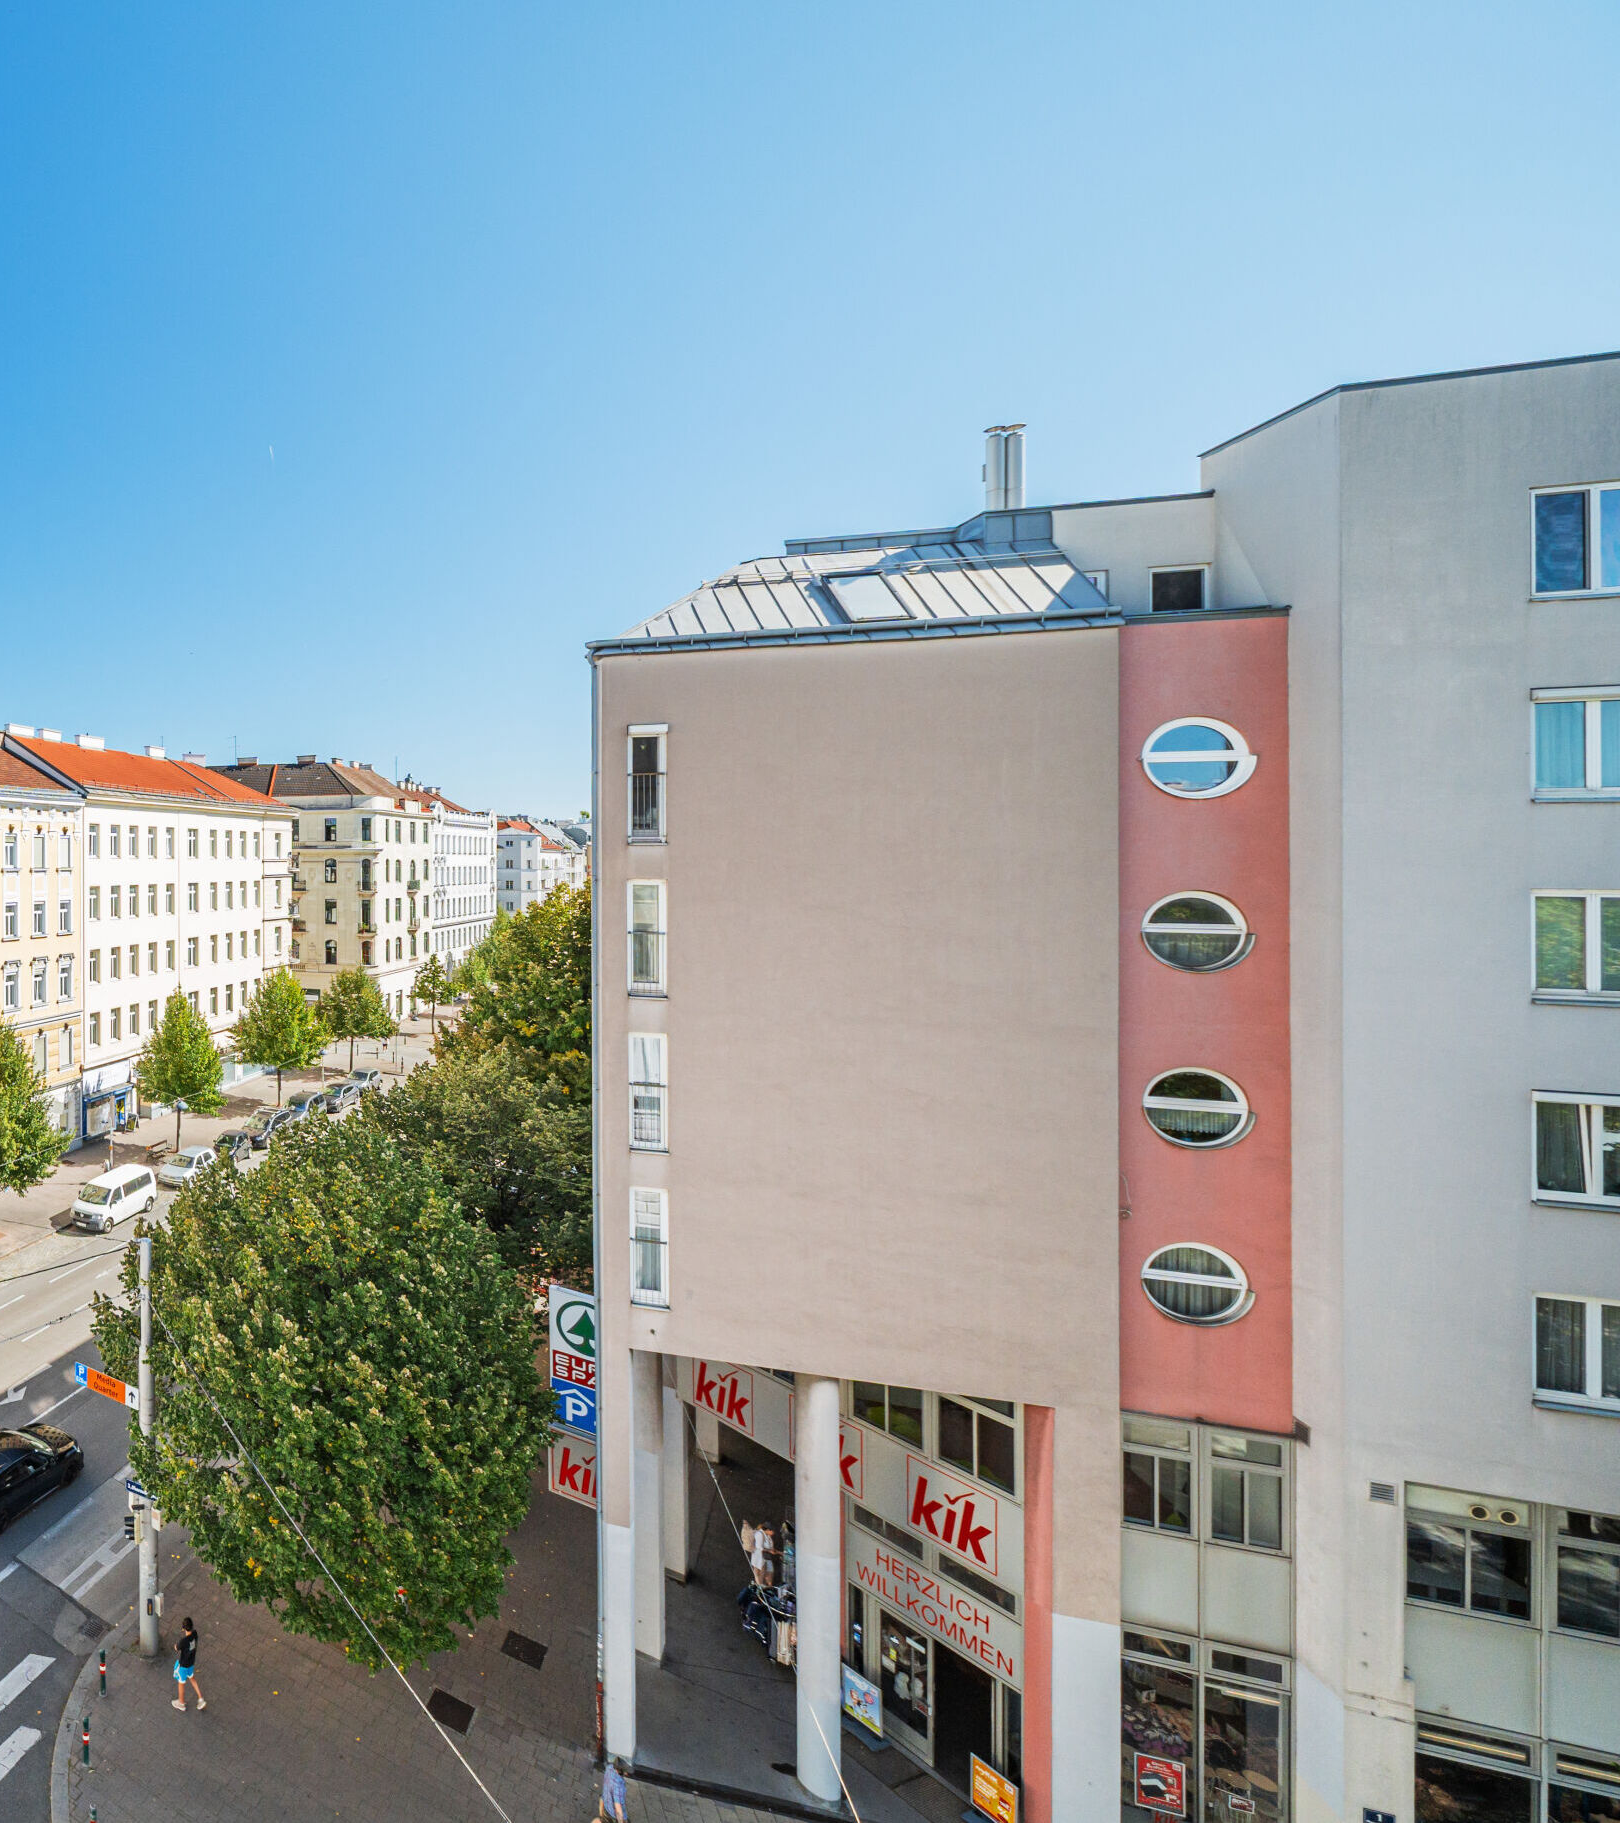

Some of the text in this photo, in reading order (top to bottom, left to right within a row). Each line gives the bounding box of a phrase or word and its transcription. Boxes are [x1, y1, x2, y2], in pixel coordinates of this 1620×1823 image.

[78, 1365, 85, 1376] P
[96, 1374, 116, 1388] Media
[93, 1382, 119, 1398] Quarter
[565, 1396, 588, 1422] P
[876, 1548, 990, 1635] HERZLICH
[856, 1561, 1014, 1677] WILLKOMMEN
